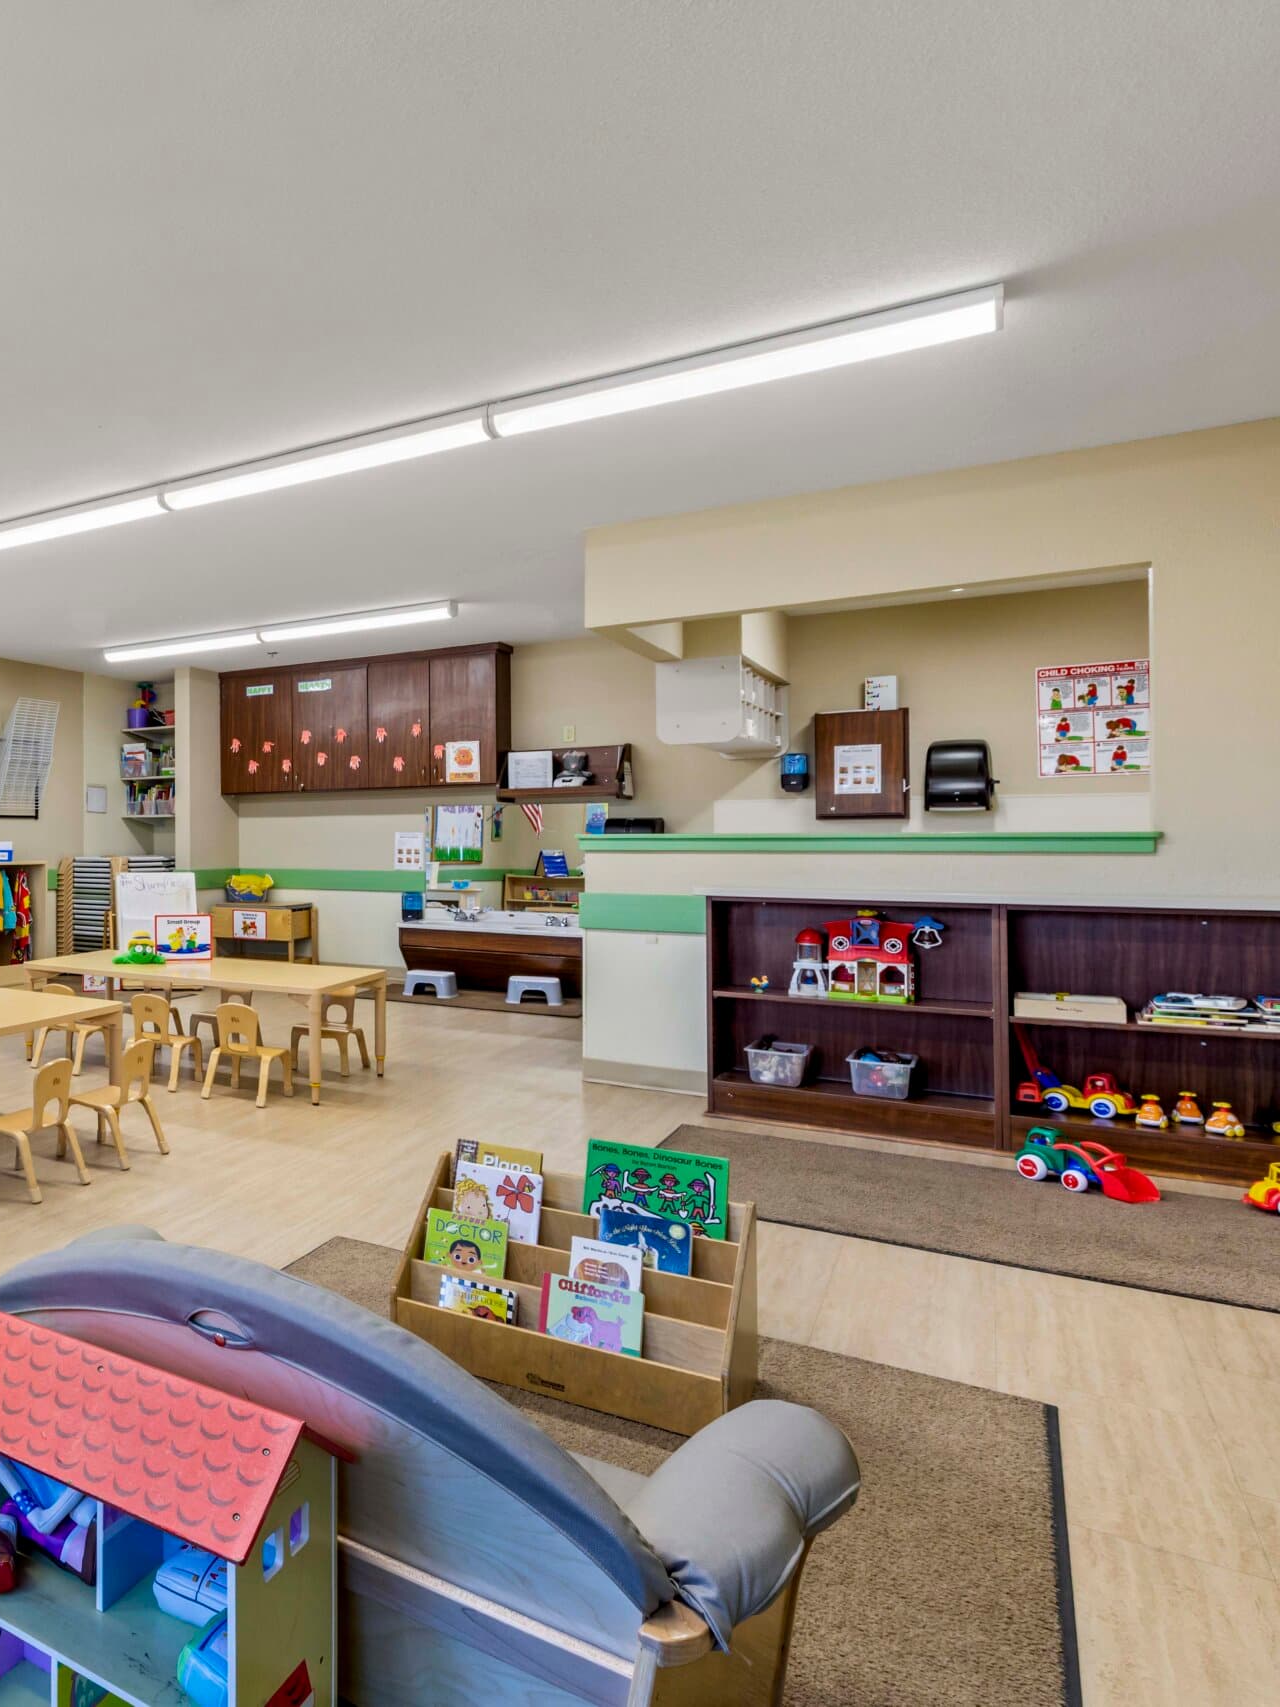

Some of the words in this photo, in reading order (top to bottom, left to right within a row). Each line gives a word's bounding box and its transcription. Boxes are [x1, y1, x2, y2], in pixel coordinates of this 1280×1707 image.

[1039, 669, 1068, 677] CHILD
[1070, 665, 1115, 675] CHOKING
[653, 1152, 692, 1166] Dinosaur
[695, 1158, 723, 1170] Bones
[436, 1218, 503, 1245] DOCTOR
[558, 1279, 631, 1305] Clifford's
